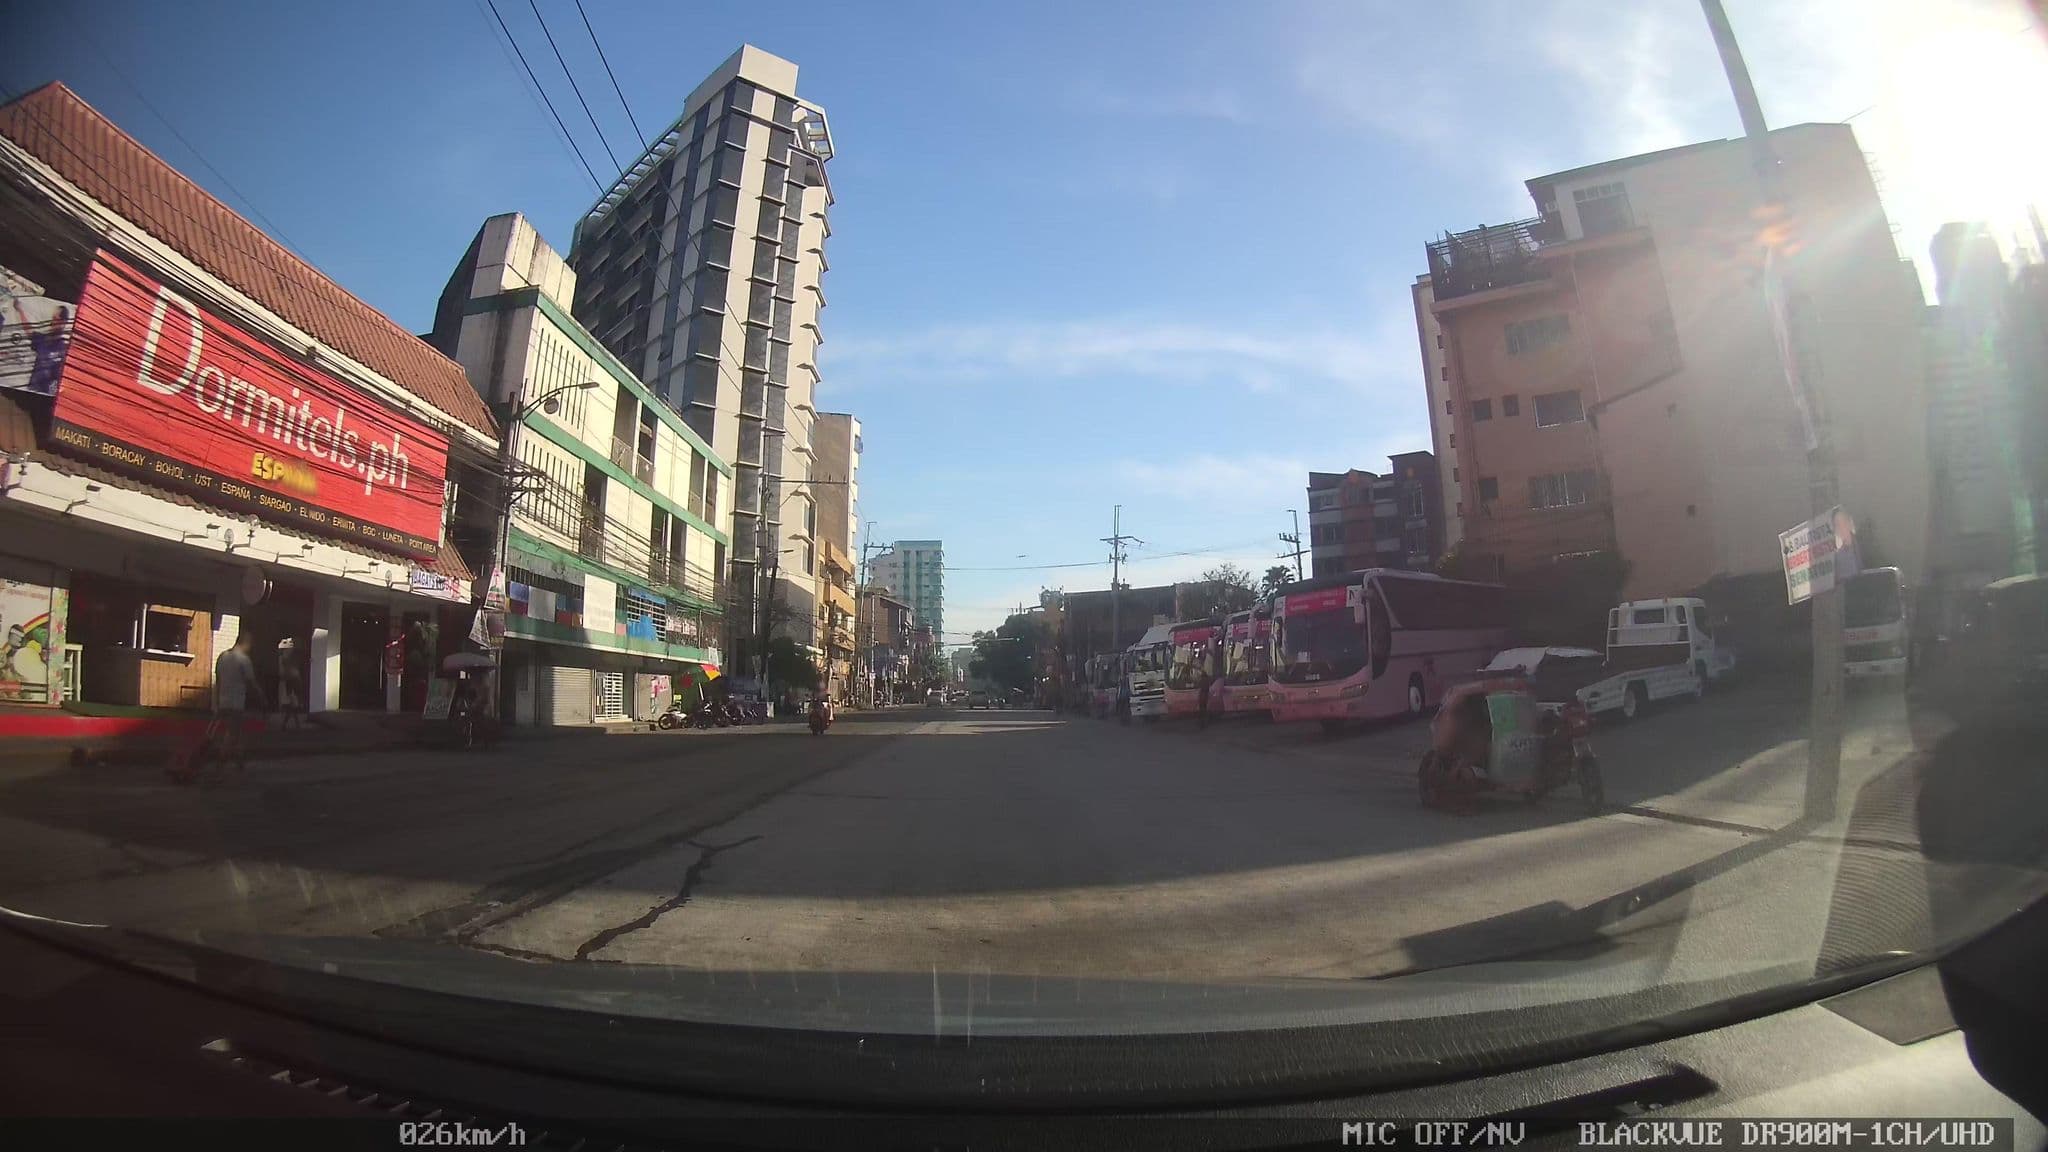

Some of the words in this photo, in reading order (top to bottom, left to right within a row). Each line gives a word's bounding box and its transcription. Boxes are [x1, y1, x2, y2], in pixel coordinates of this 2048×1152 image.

[137, 285, 411, 496] Dormitels.ph
[55, 427, 91, 449] MAKATI
[101, 442, 146, 466] BORACAY
[155, 460, 185, 480] BOHOL
[194, 473, 213, 488] UST
[220, 482, 251, 501] ESPAÑA
[259, 495, 293, 513] SIARGAO
[299, 506, 309, 518] EL
[332, 517, 356, 532] ERMITA
[382, 531, 404, 545] LUNETA
